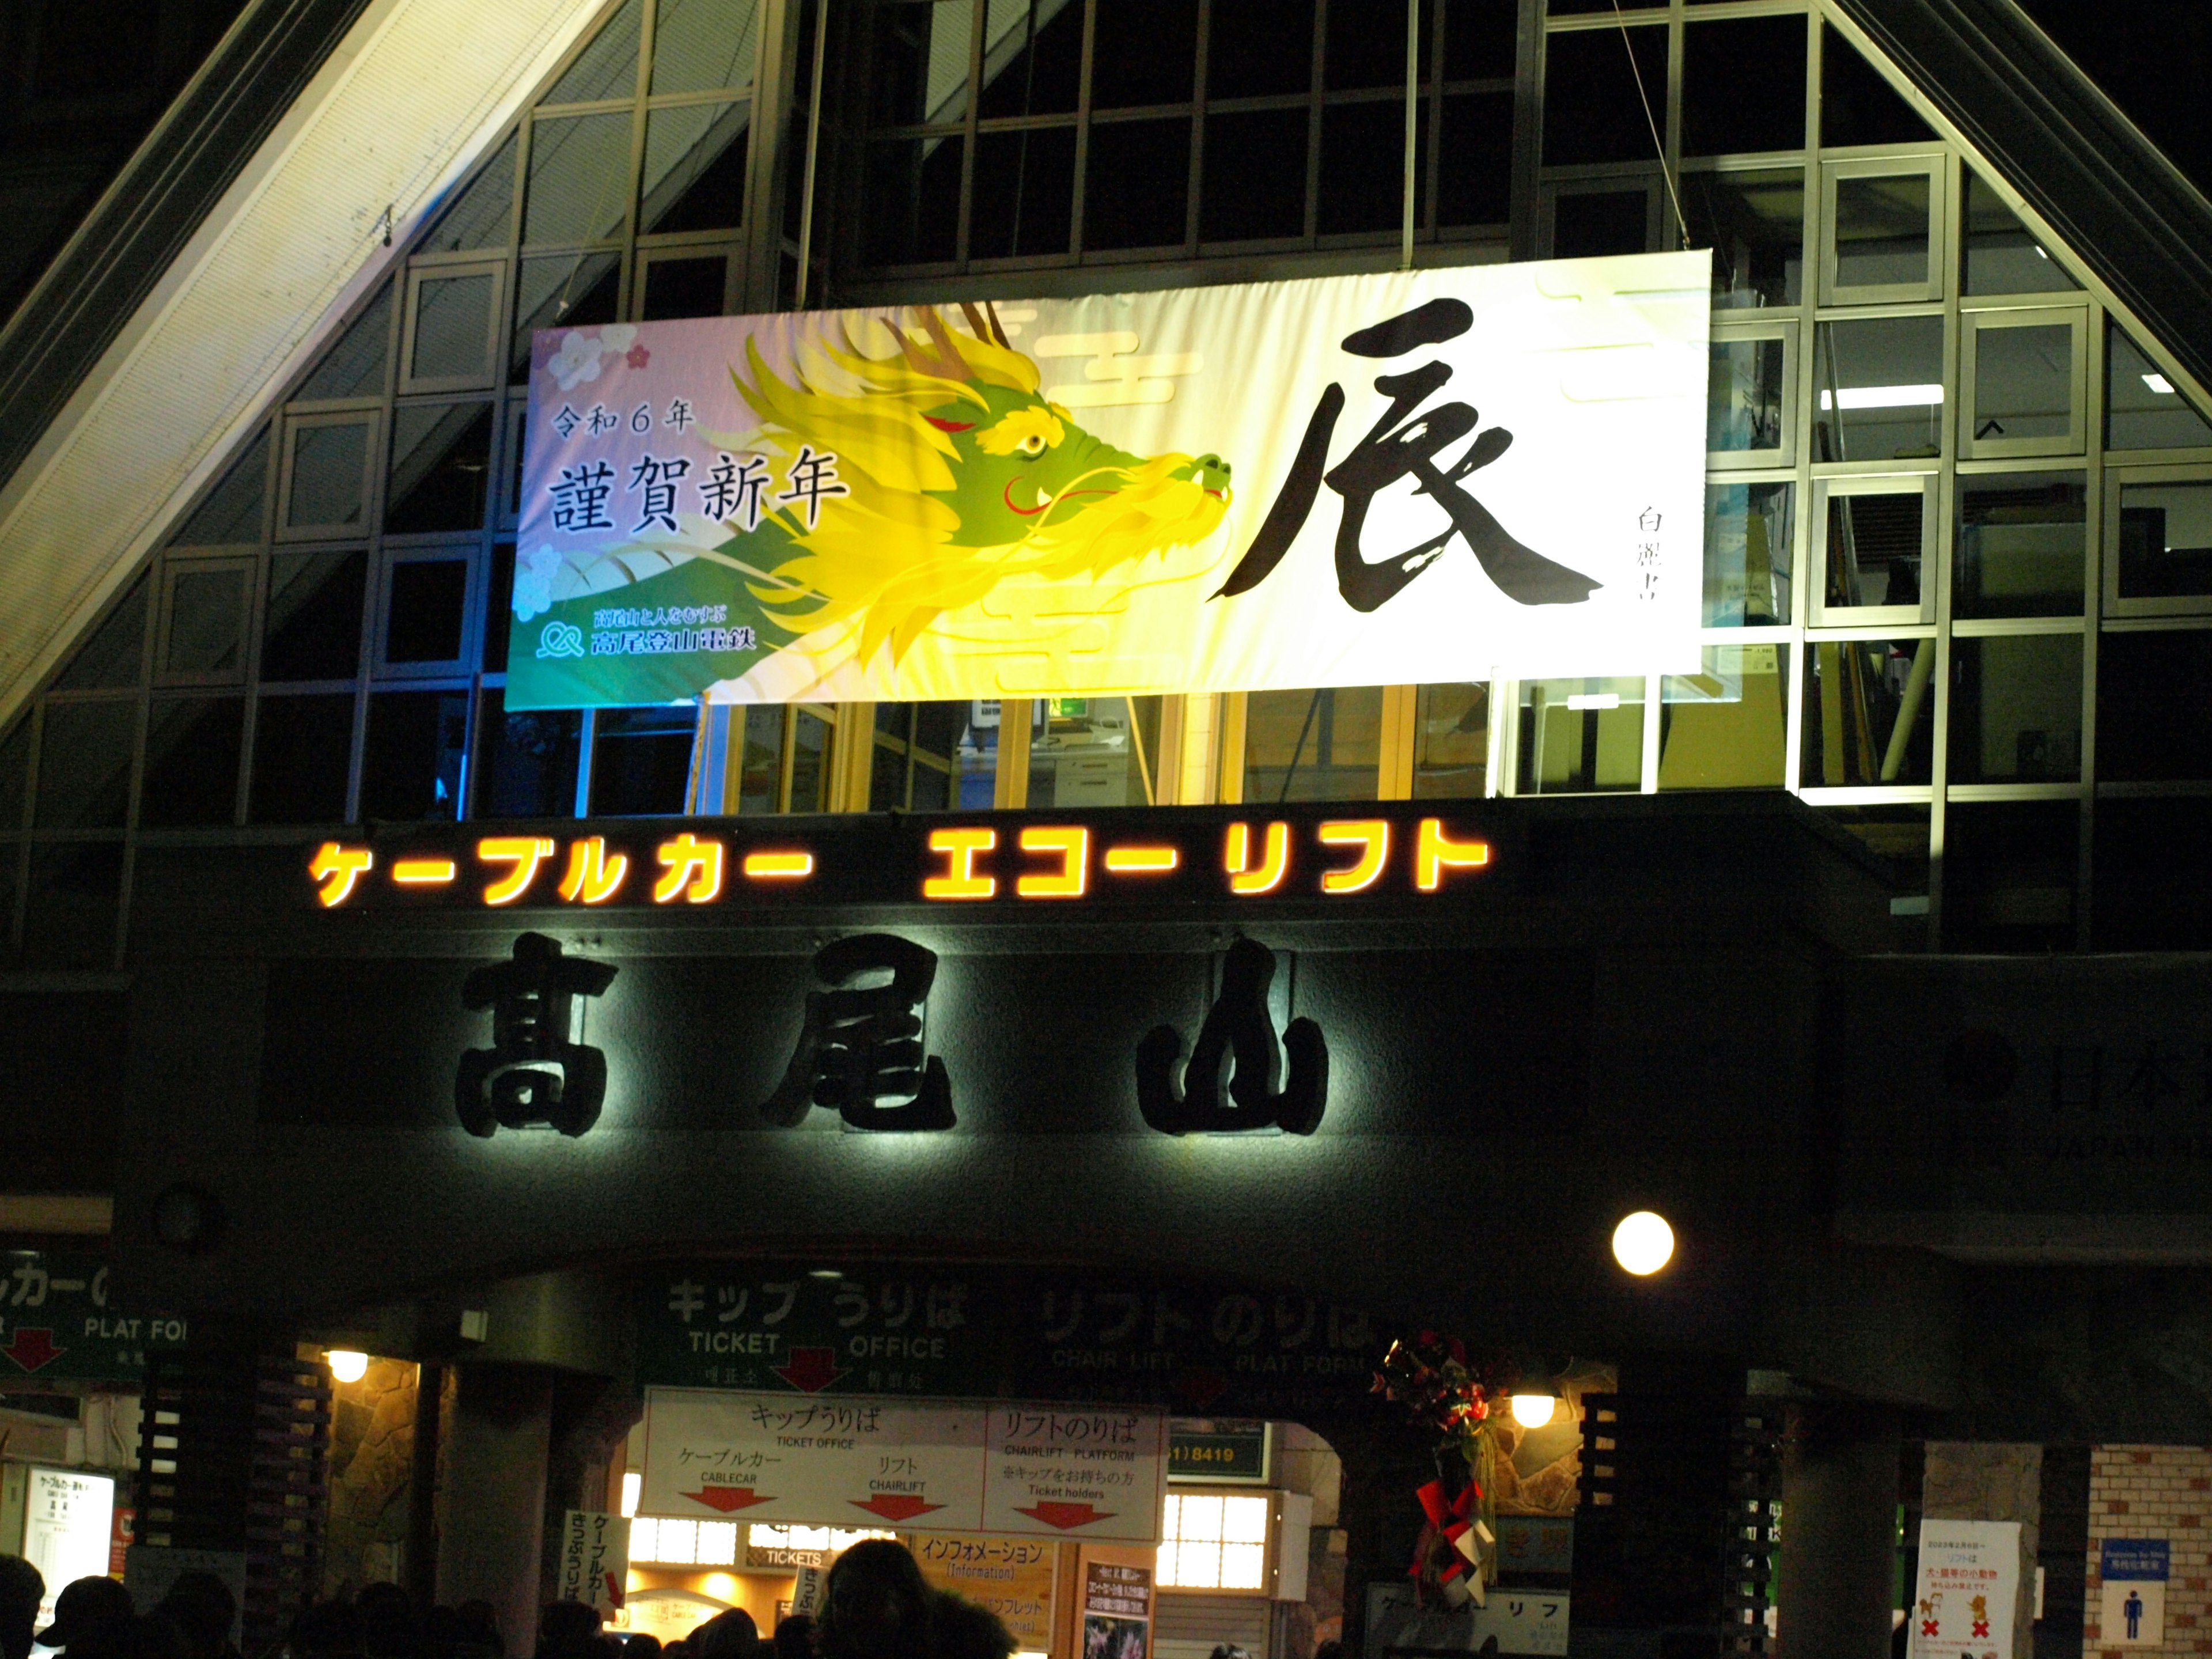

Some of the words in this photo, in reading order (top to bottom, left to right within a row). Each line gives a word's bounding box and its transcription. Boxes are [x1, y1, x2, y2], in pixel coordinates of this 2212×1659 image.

[553, 400, 694, 438] 令和6年
[1206, 297, 1605, 613] 辰
[549, 449, 847, 531] 謹賀新年
[592, 628, 757, 654] 高尾登山電鉄
[309, 833, 816, 908] ケーブルカー
[922, 826, 1179, 899] エコー
[1227, 818, 1492, 896] リフト
[455, 932, 1328, 1137] 高尾山
[690, 1331, 781, 1355] TICKET
[849, 1336, 946, 1359] OFFICE
[751, 1403, 881, 1433] キップうりば
[1007, 1411, 1140, 1444] リフトのりば
[777, 1435, 813, 1449] TICKET
[817, 1438, 855, 1450] OFFICE
[1005, 1445, 1064, 1460] CHAIRLIFT
[1074, 1447, 1135, 1462] PLATFORM
[679, 1448, 781, 1467] ケーブルカー
[1168, 1446, 1235, 1463] 1)8419
[880, 1457, 918, 1475] リフト
[700, 1472, 757, 1485] CABLECAR
[869, 1479, 926, 1492] CHAIRLIFT
[1028, 1484, 1063, 1498] Ticket
[1065, 1486, 1105, 1499] holders
[767, 1550, 822, 1566] TICKETS
[922, 1539, 1044, 1565] インフォメーション
[947, 1563, 1014, 1580] (Information)
